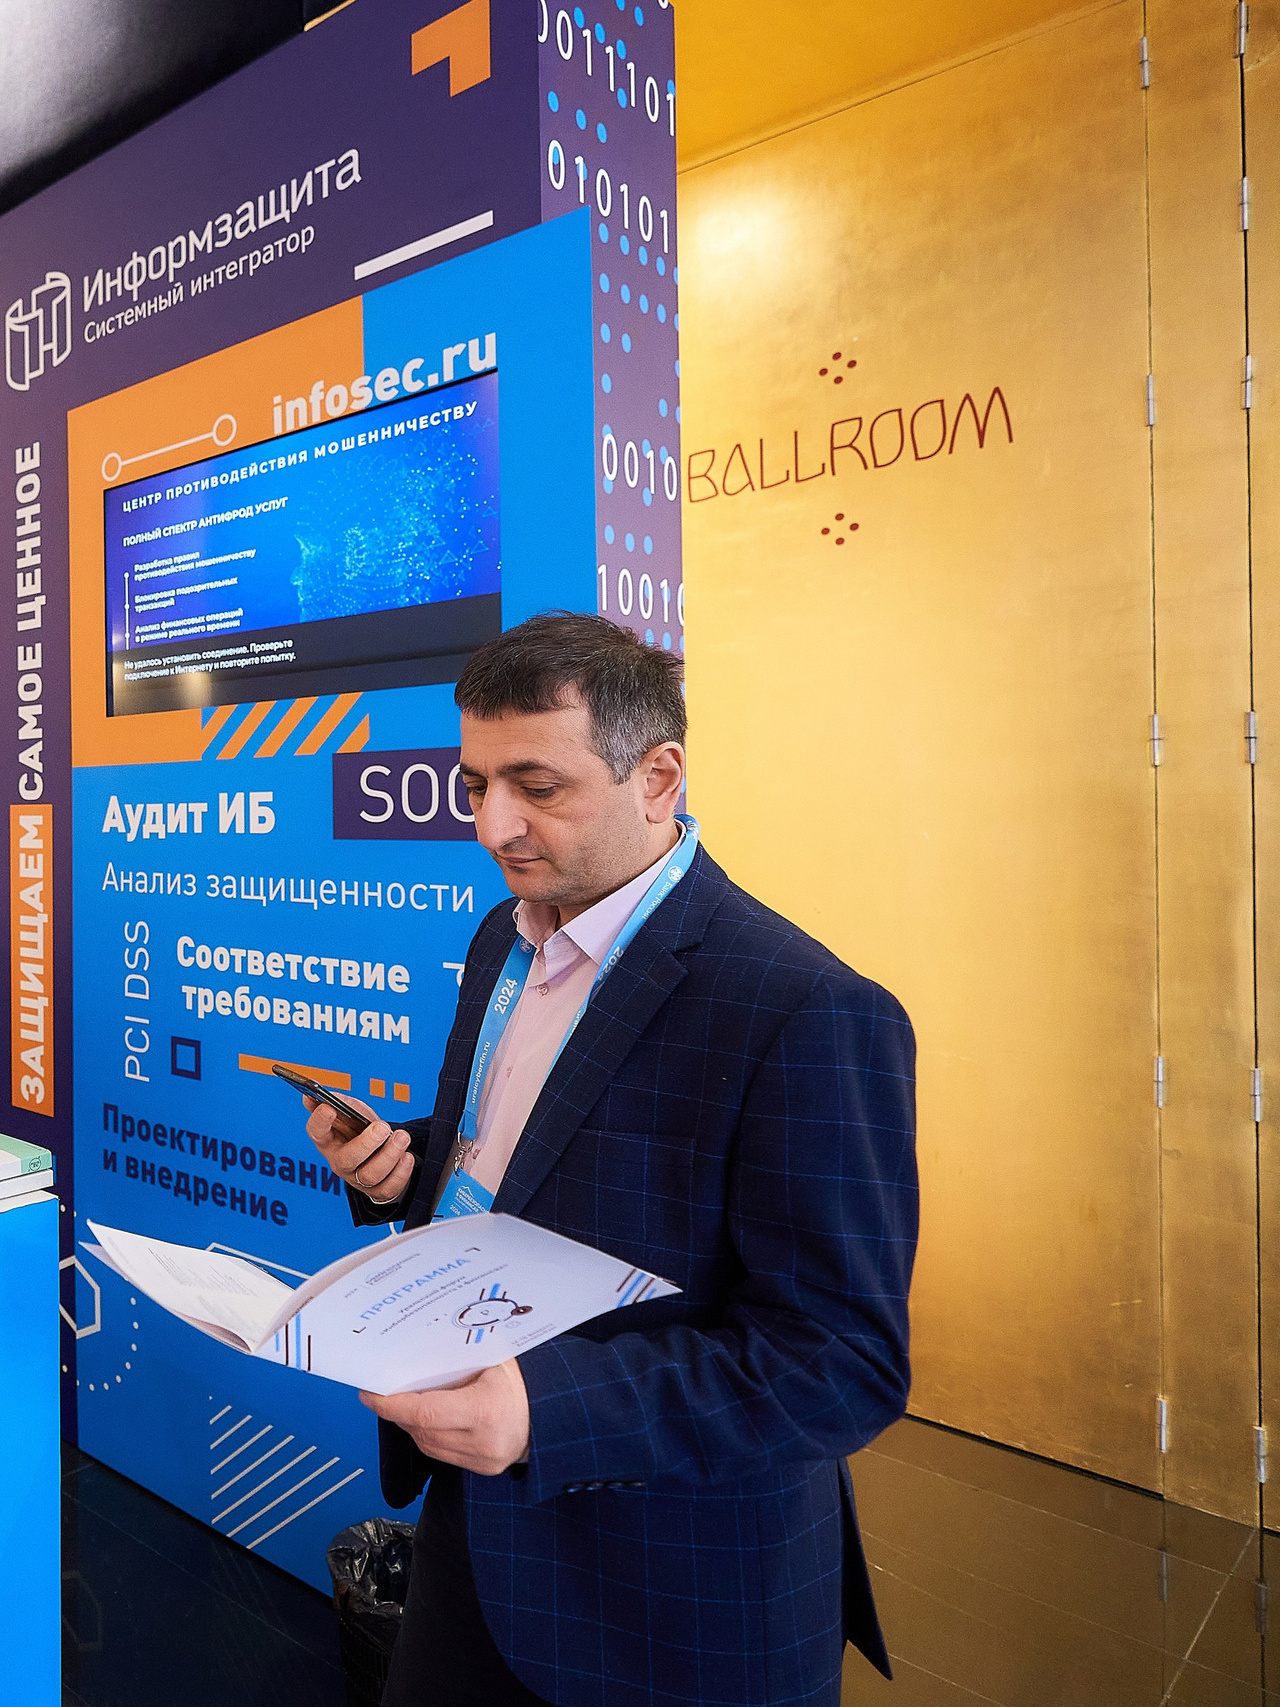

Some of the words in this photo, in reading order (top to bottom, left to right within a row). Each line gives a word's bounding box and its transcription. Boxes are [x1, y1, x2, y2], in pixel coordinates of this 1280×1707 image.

[83, 148, 362, 312] Информзащита
[547, 139, 670, 253] 010101
[83, 281, 184, 344] Системный
[190, 224, 316, 298] интегратор
[272, 331, 498, 436] infosec.ru
[123, 491, 162, 513] ЦЕНТР
[166, 450, 308, 501] ПРОТИВОДЕЙСТВИЯ
[314, 400, 479, 459] МОШЕННИЧЕСТВУ
[687, 386, 1014, 504] BALLROOM
[15, 441, 47, 632] ЦЕННОЕ
[123, 527, 162, 547] ПОЛНЫЙ
[162, 519, 198, 538] СПЕКТР
[198, 507, 254, 530] АНТИФРОД
[254, 496, 288, 518] УСЛУГ
[18, 641, 45, 802] САМОЕ
[102, 795, 208, 842] Аудит
[218, 790, 277, 835] ИБ
[101, 861, 198, 897] Анализ
[205, 873, 476, 914] защищенности
[16, 812, 54, 1106] ЗАЩИЩАЕМ
[123, 919, 150, 1003] DSS
[176, 935, 411, 995] Соответствие
[494, 978, 518, 1015] 2024
[124, 1014, 150, 1084] PCI
[181, 982, 411, 1046] требованиям
[470, 1040, 491, 1105] uralcyberfin.ru
[103, 1102, 347, 1198] Проектировани
[103, 1148, 117, 1174] и
[125, 1154, 288, 1227] внедрение
[359, 1257, 470, 1321] ПРОГРАММА
